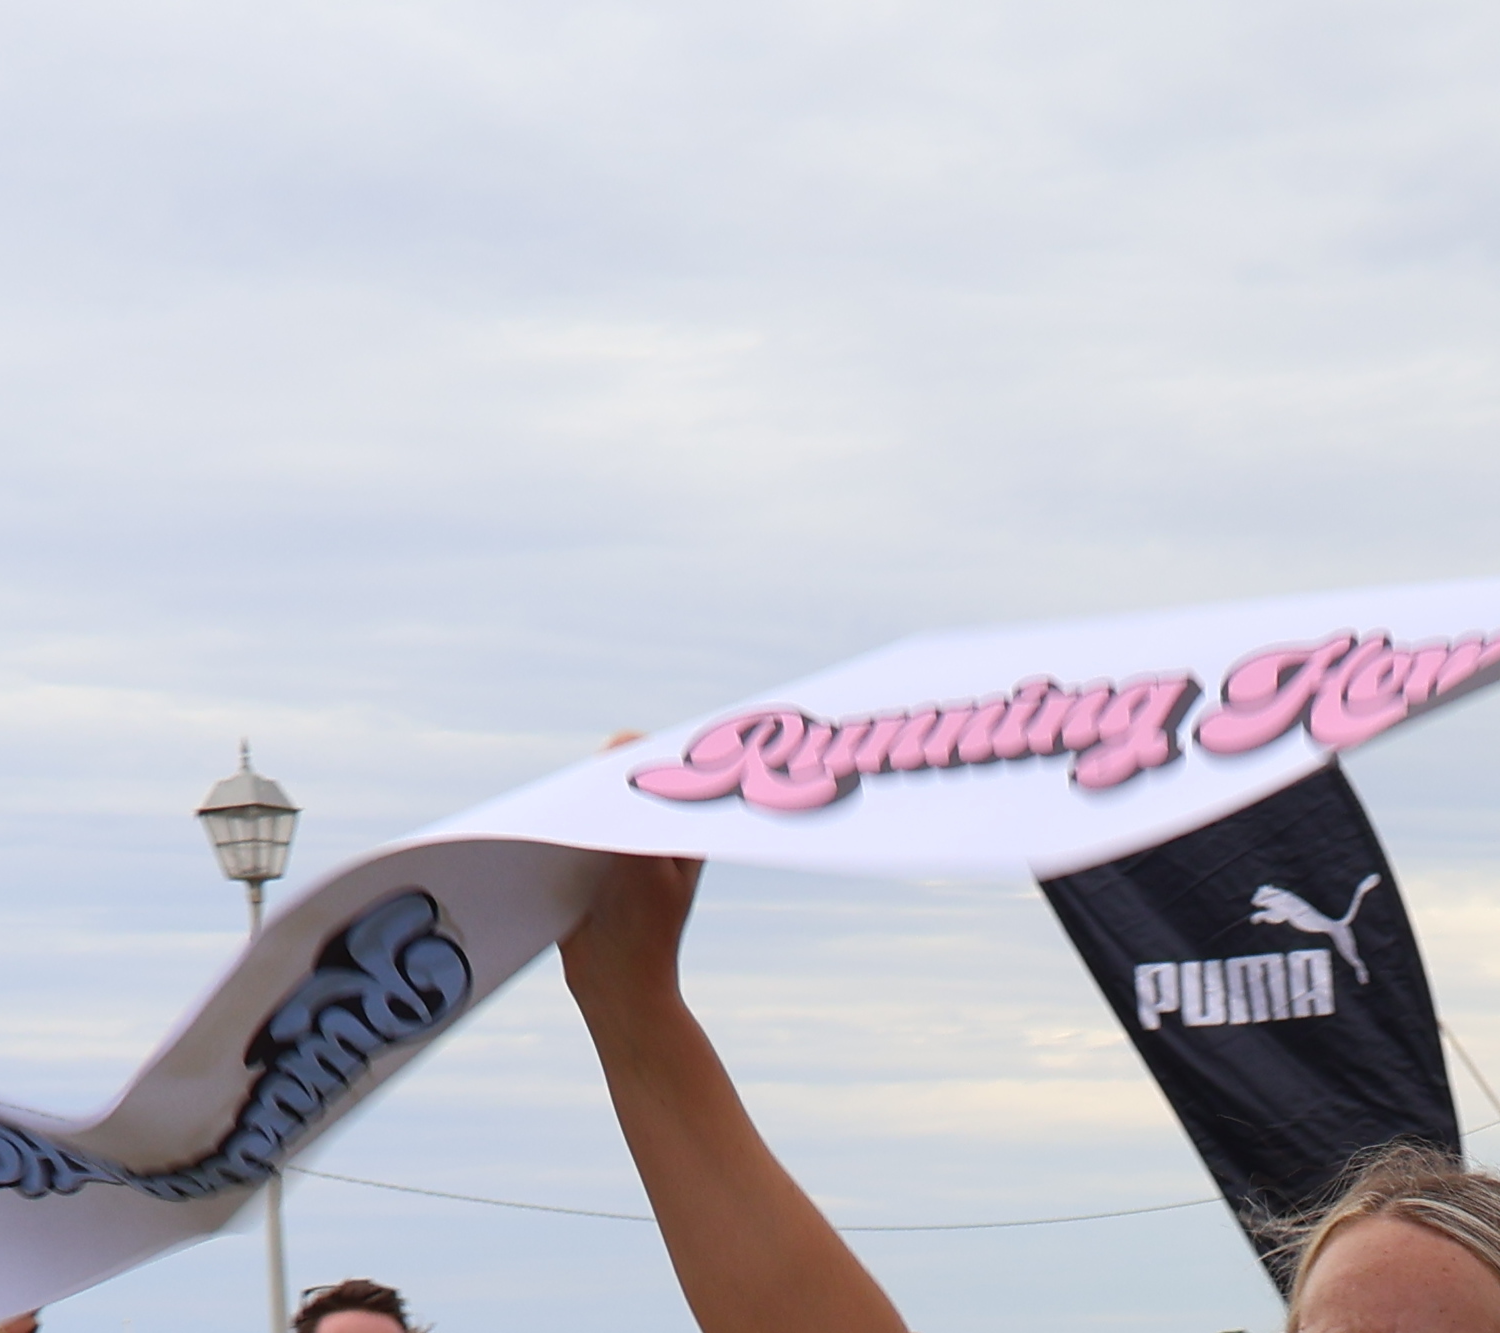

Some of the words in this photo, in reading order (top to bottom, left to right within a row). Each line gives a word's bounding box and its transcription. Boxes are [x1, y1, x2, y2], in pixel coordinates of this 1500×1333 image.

[626, 672, 1202, 810] Running
[121, 888, 473, 1202] Runnin
[1134, 949, 1335, 1030] PUMA
